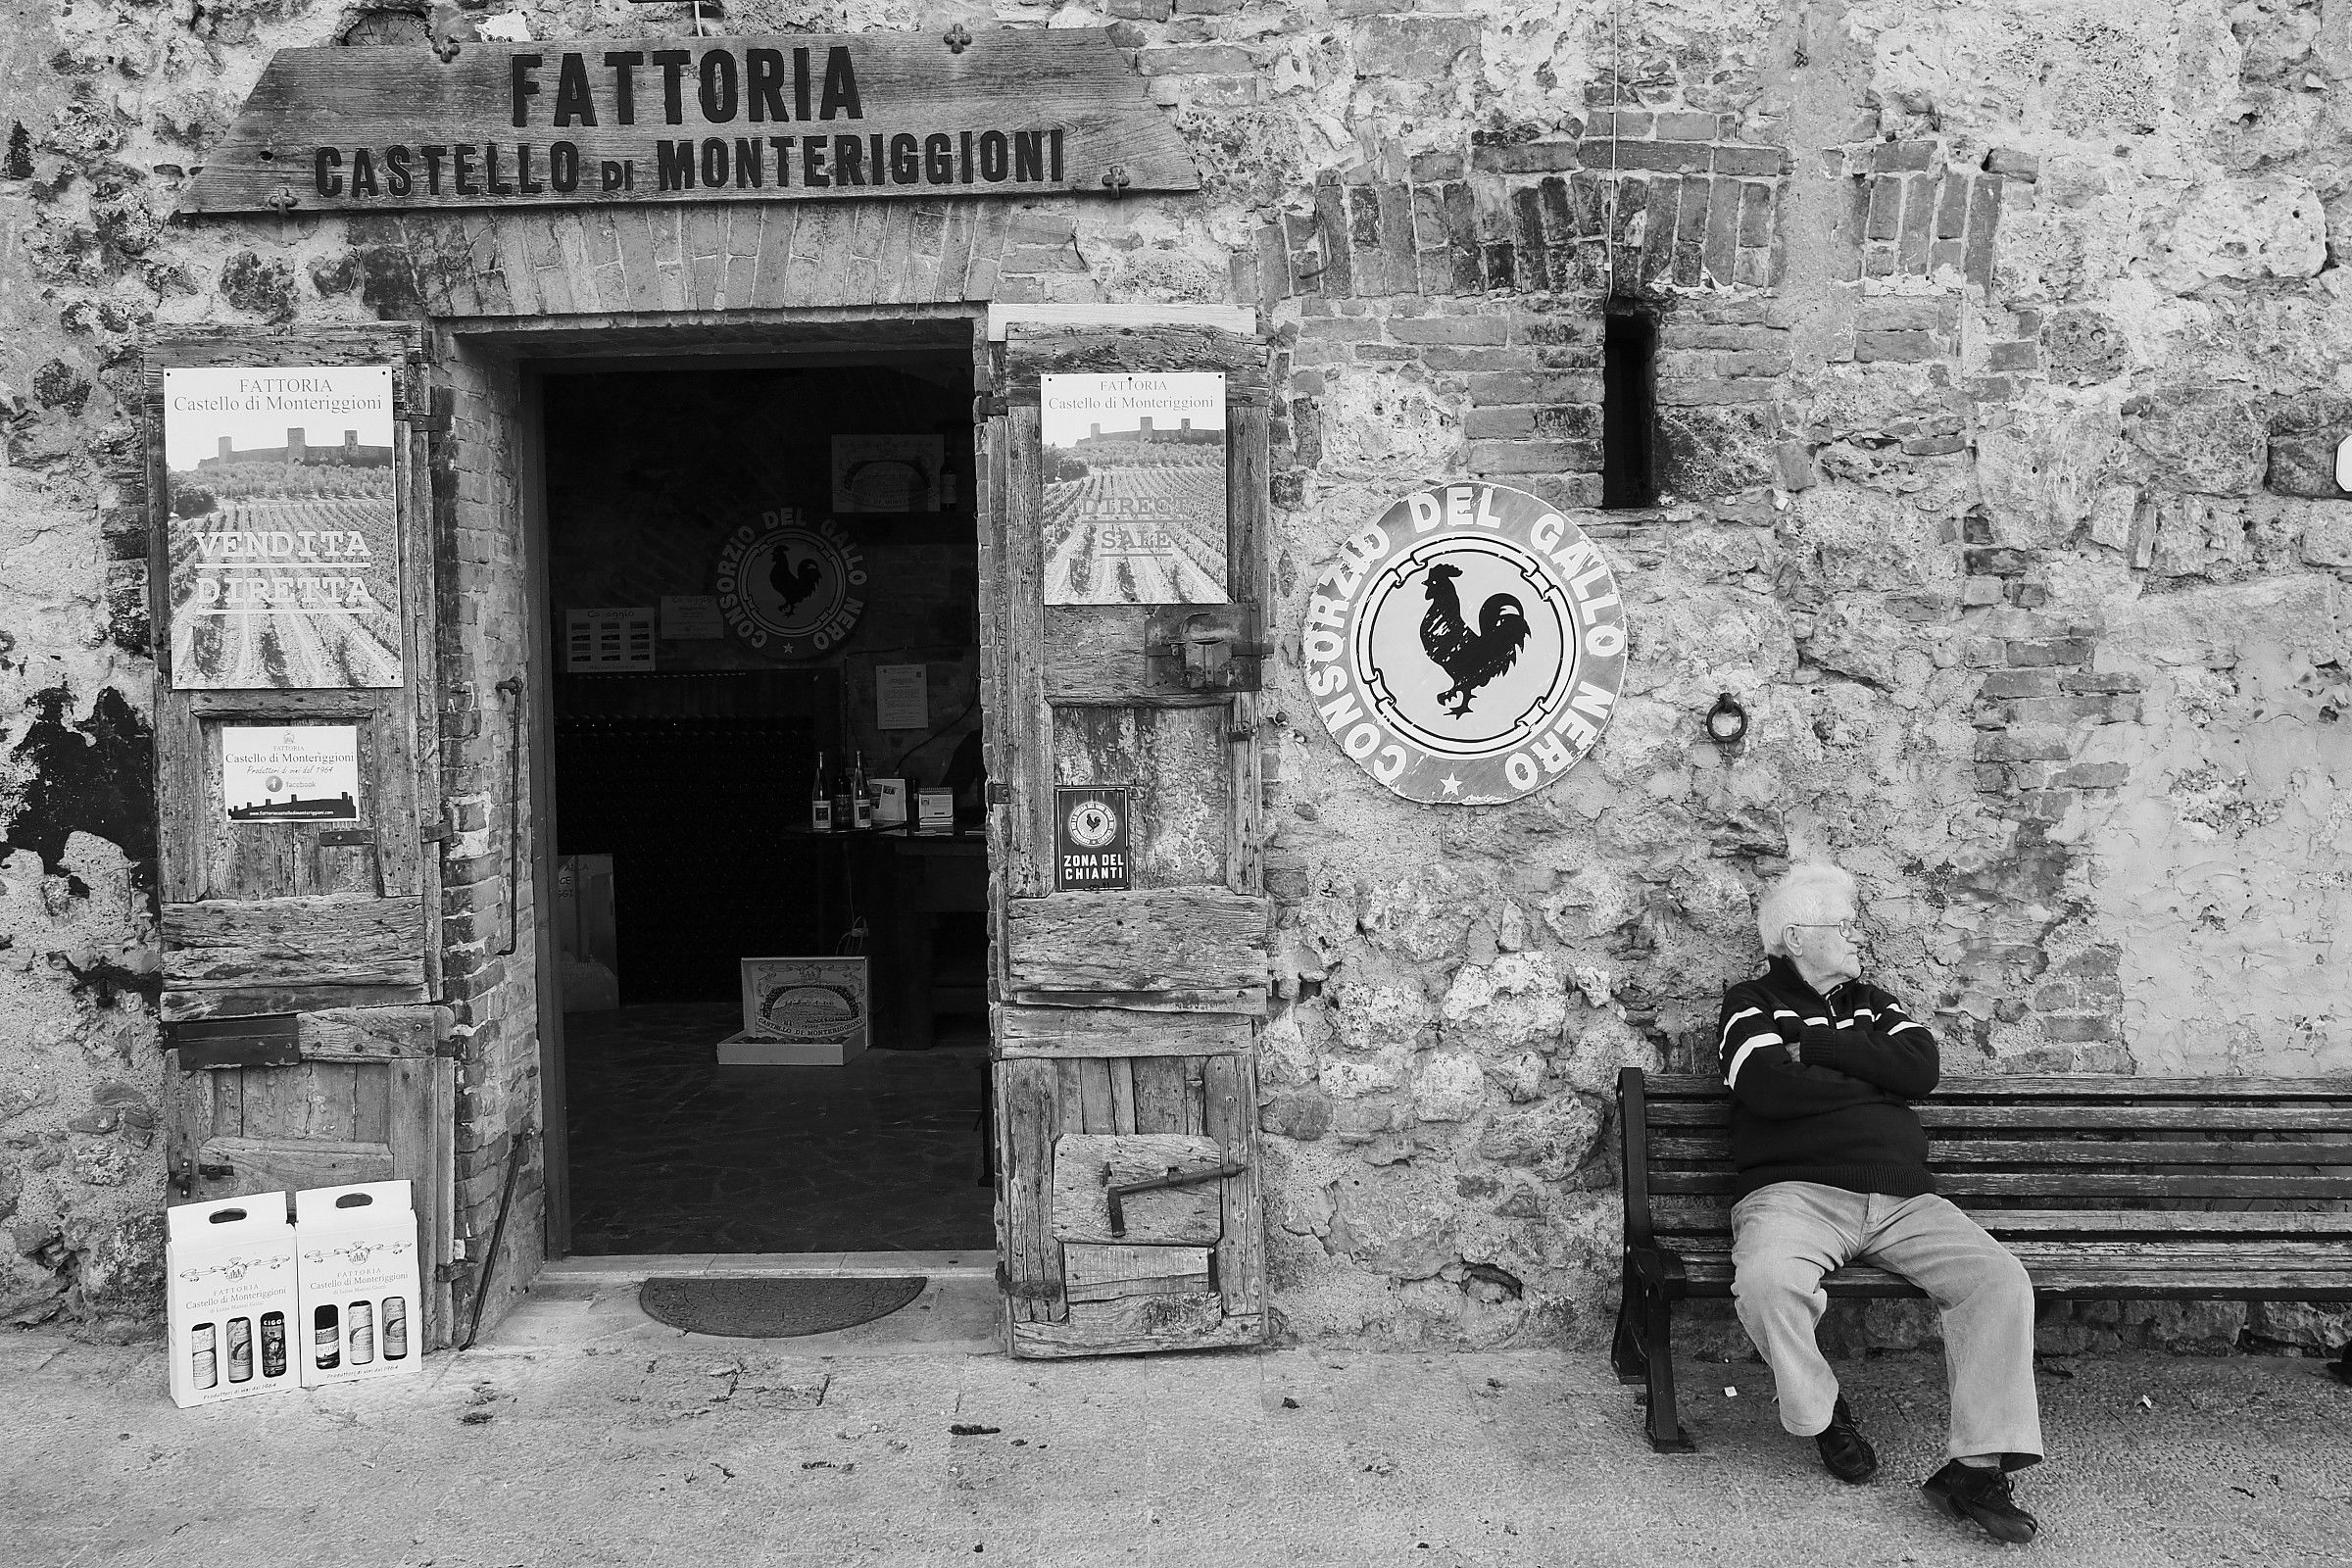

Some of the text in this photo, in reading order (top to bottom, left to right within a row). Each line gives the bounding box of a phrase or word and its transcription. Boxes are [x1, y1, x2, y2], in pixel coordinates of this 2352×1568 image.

[511, 46, 863, 128] FATTORIA
[315, 128, 1064, 197] CASTELLO DI MONTERIGGIONI
[240, 378, 333, 393] FATTORIA
[1101, 380, 1167, 391] FATTORIA
[173, 394, 382, 413] Castello di Monteriggioni
[1049, 396, 1214, 411] Castello di Monteriggioni
[1081, 497, 1190, 515] DIRECT
[193, 530, 372, 558] VENDITA
[1102, 530, 1172, 549] SALE
[716, 507, 867, 650] CONSORZIO DEL GALLO NERO
[196, 576, 373, 604] DIRETTA
[1305, 487, 1625, 791] CONSORZIO DEL GALLO NERO
[225, 752, 354, 764] Castello di Monteriggioni
[1064, 854, 1124, 867] ZONA DEL
[1065, 867, 1123, 881] CHIANTI
[310, 1279, 342, 1291] Castello
[354, 1271, 409, 1285] Monteriggioni
[337, 1267, 381, 1278] FATTORIA
[185, 1297, 220, 1310] Castello
[220, 1296, 229, 1304] di
[230, 1286, 287, 1302] Monteriggioni
[214, 1284, 260, 1297] FATTORIA
